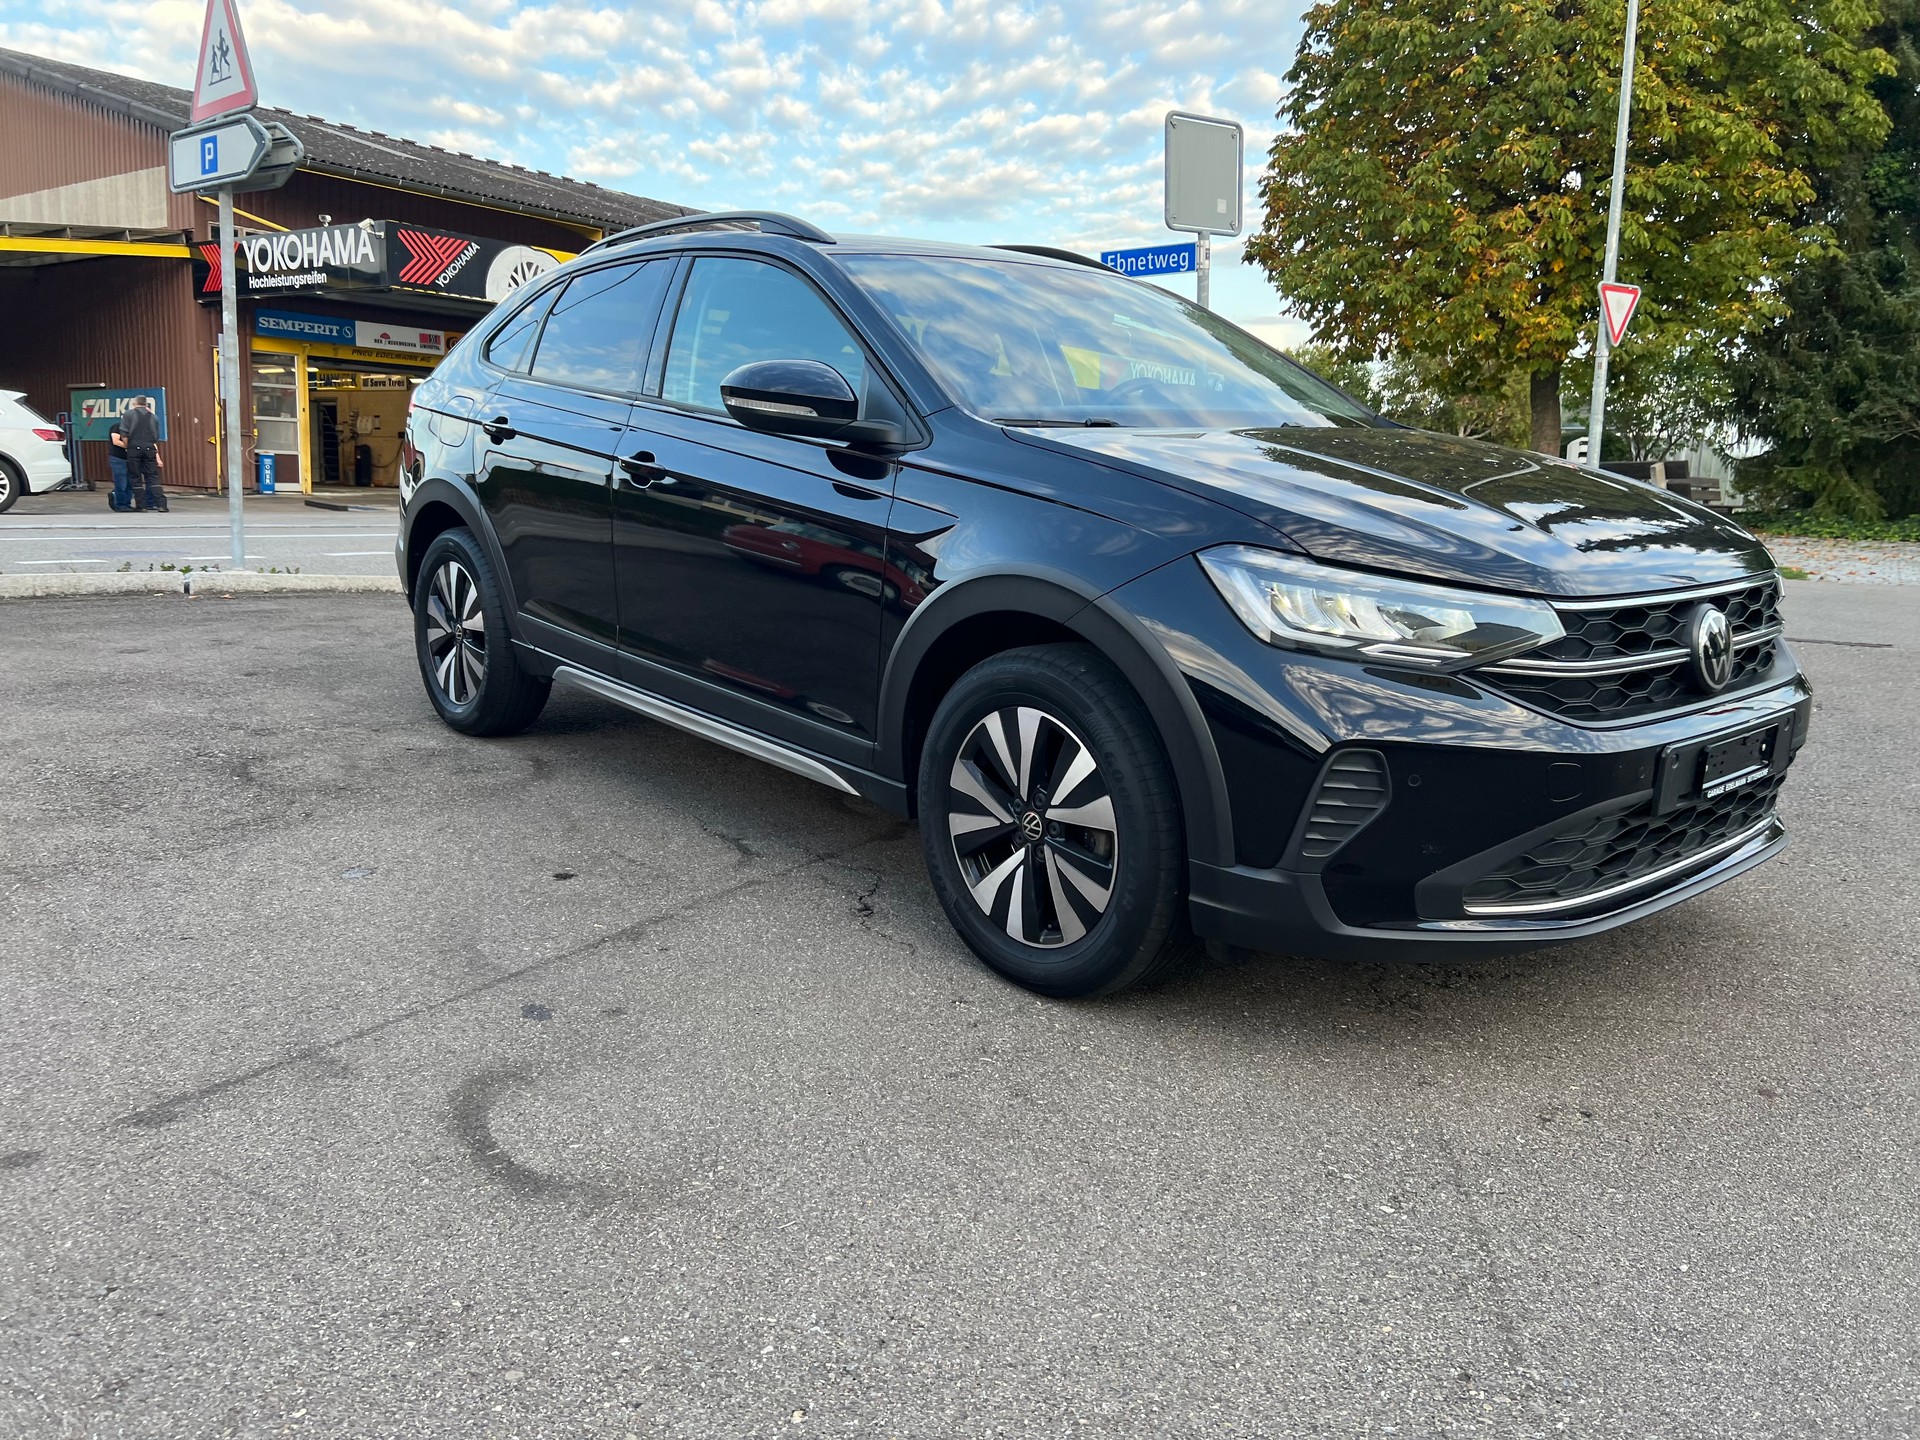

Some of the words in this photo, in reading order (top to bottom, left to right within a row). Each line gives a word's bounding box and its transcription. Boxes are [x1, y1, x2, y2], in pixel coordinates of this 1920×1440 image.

[204, 142, 214, 170] P
[242, 228, 375, 273] YOKOHAMA
[435, 242, 481, 288] YOKOHAMA
[1107, 252, 1189, 272] Ebnetweg
[248, 271, 327, 289] Hochleistungsreifen
[258, 316, 340, 336] SEMPERIT
[370, 378, 386, 387] Sava
[1130, 362, 1195, 385] YOKOHAMA
